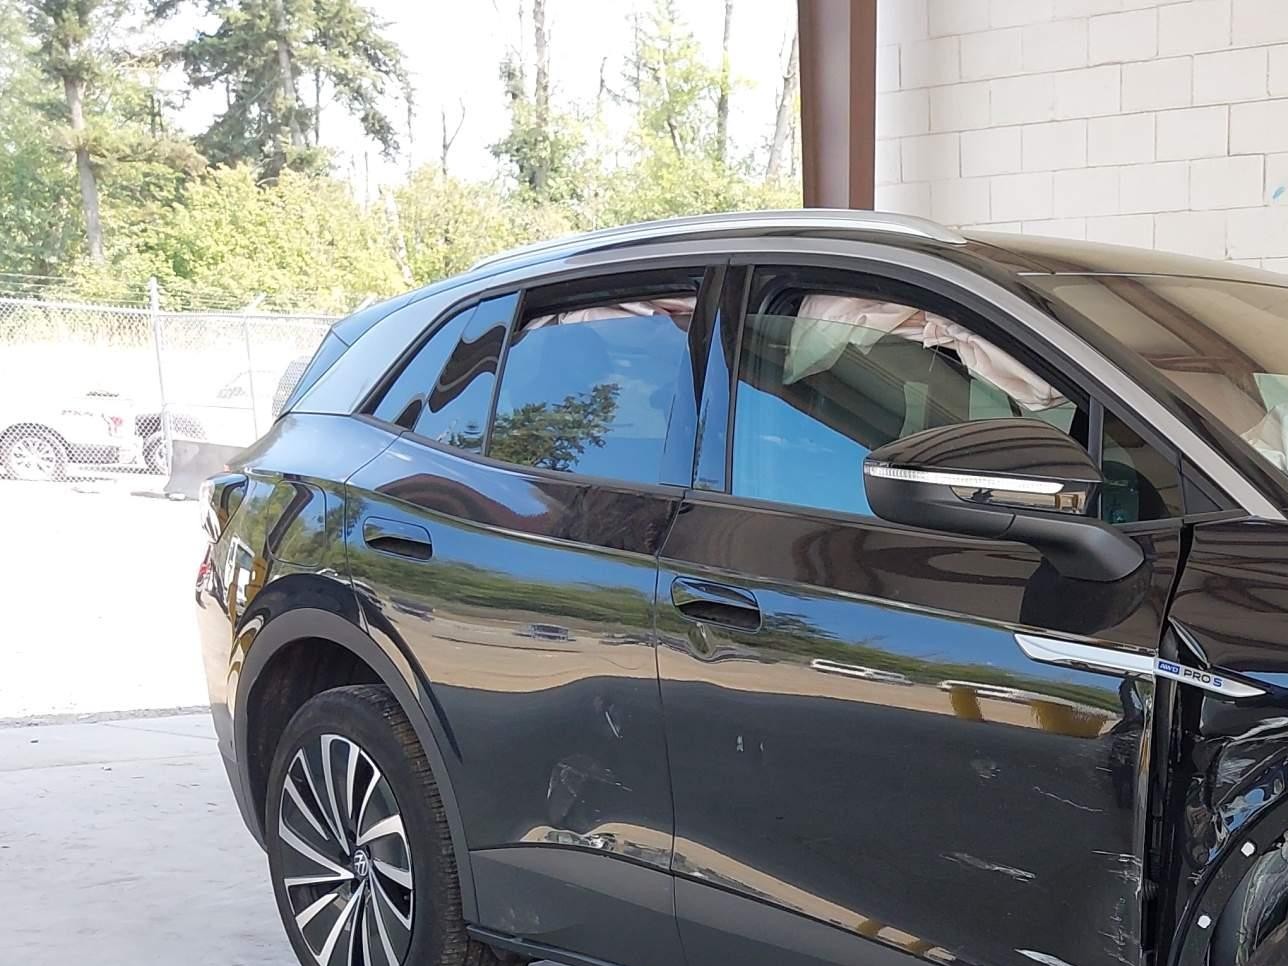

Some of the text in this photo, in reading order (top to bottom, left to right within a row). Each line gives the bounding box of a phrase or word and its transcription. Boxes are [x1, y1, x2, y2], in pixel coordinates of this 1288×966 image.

[1159, 662, 1223, 688] AWD PRO S
